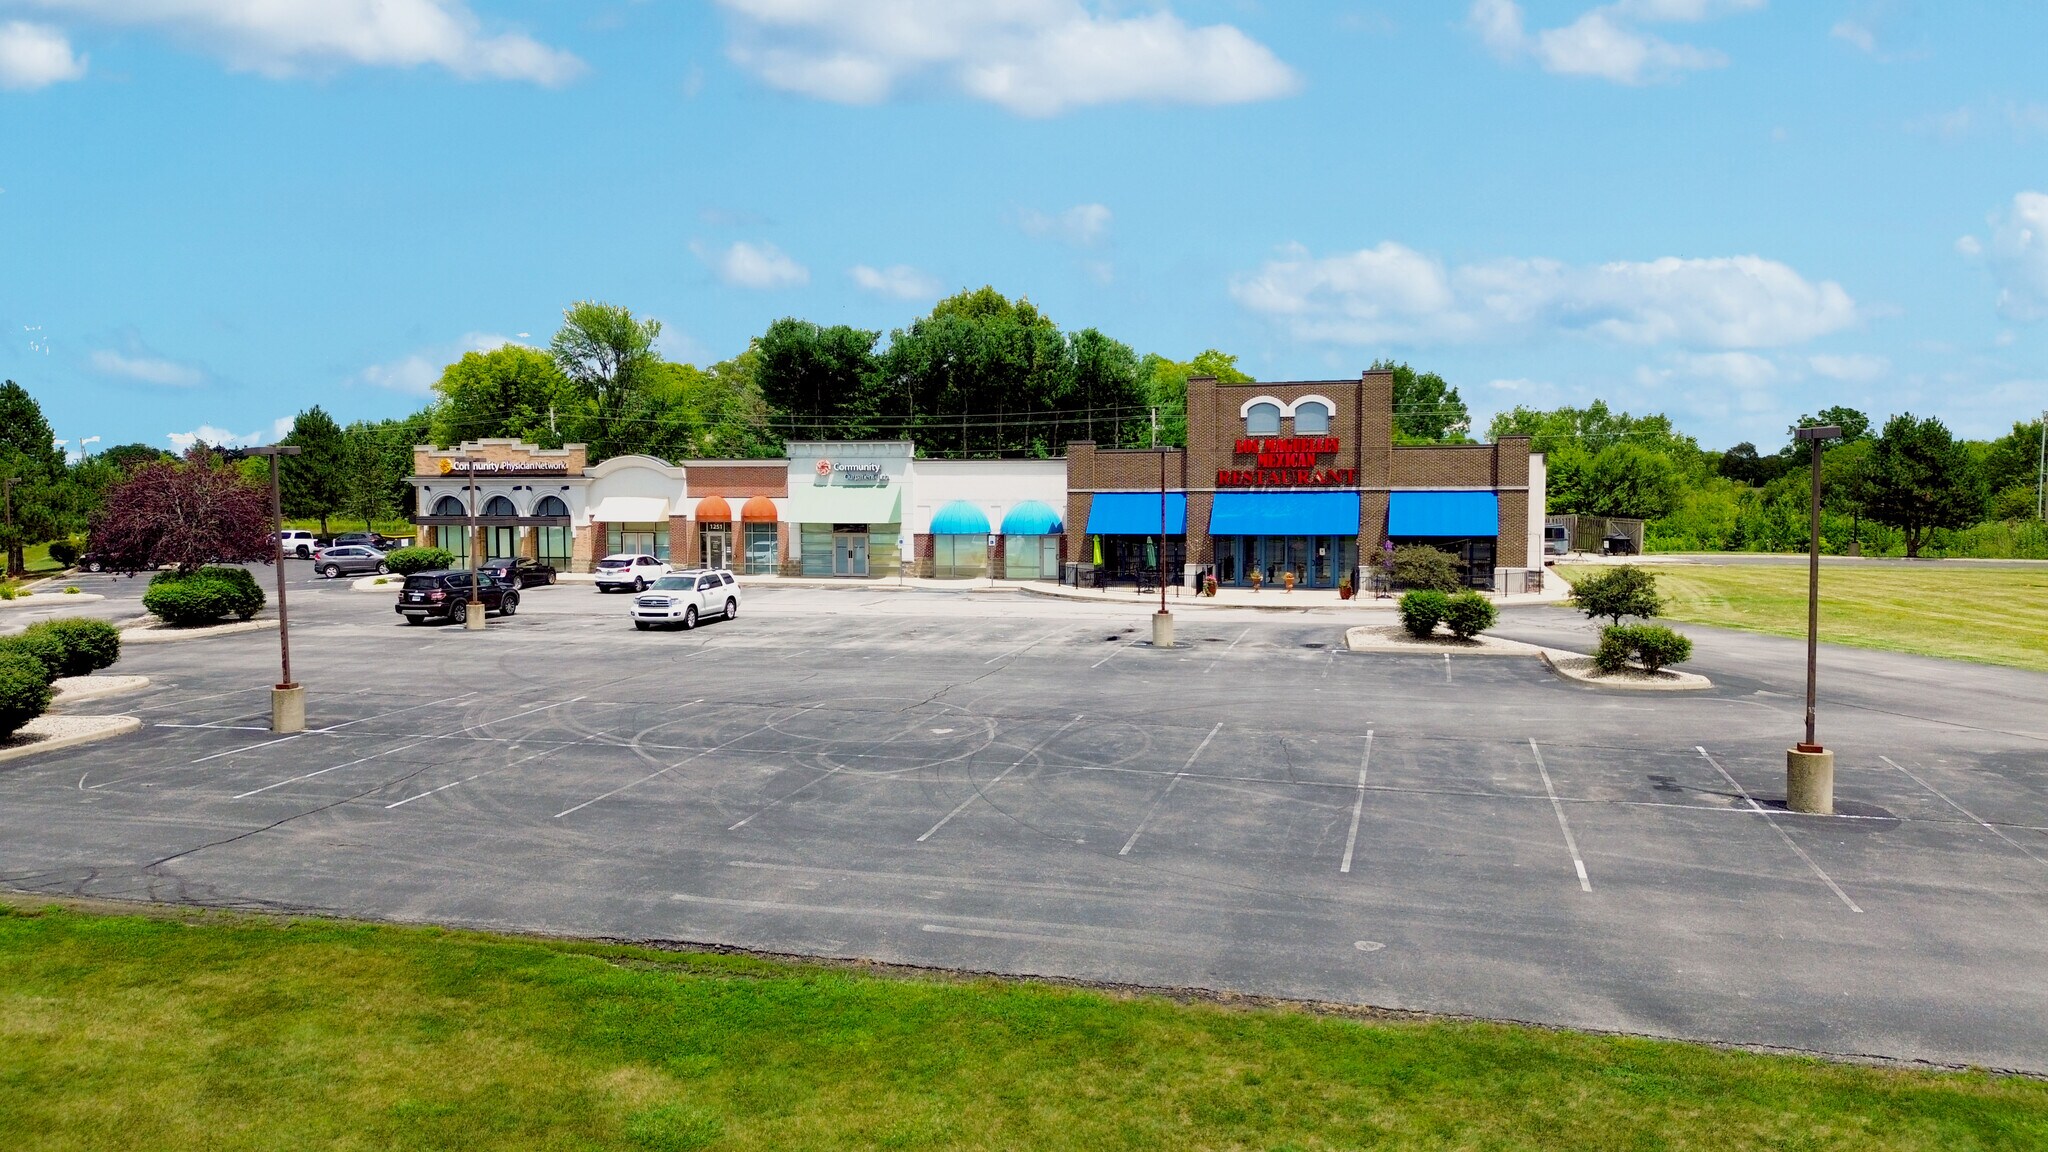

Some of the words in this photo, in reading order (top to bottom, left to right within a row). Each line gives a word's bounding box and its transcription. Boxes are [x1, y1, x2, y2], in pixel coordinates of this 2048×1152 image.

[1236, 438, 1260, 453] LOS
[502, 461, 534, 471] Physician
[535, 461, 566, 469] Network
[1256, 453, 1317, 467] MEXICAN
[833, 463, 879, 472] Community
[1218, 469, 1357, 484] RESTAURANT
